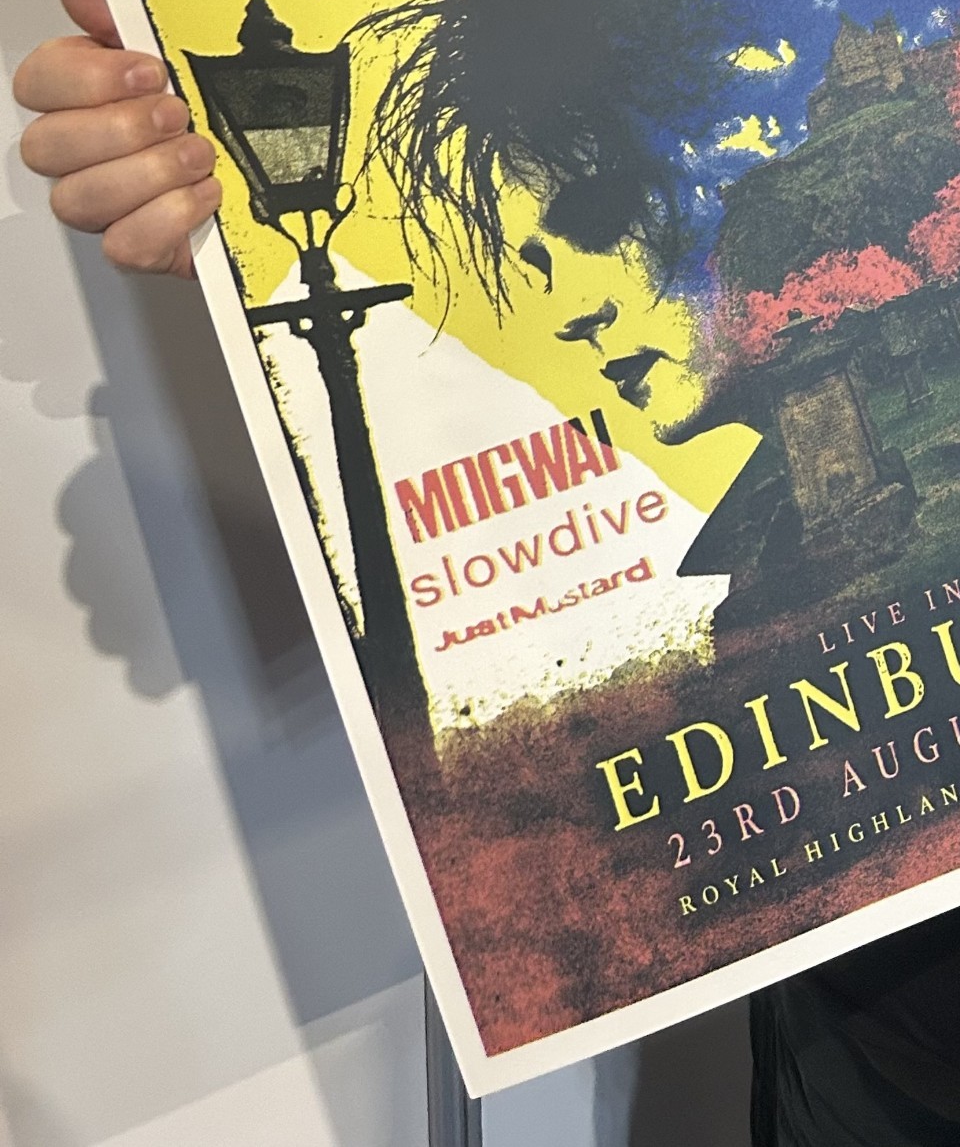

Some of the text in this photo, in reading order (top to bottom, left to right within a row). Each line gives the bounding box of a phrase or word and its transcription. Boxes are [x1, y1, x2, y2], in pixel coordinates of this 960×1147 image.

[395, 408, 622, 543] MOGWAI
[410, 490, 669, 607] slowdive
[817, 601, 908, 654] LIVE
[667, 784, 803, 869] 23RD
[679, 851, 788, 915] ROYAL
